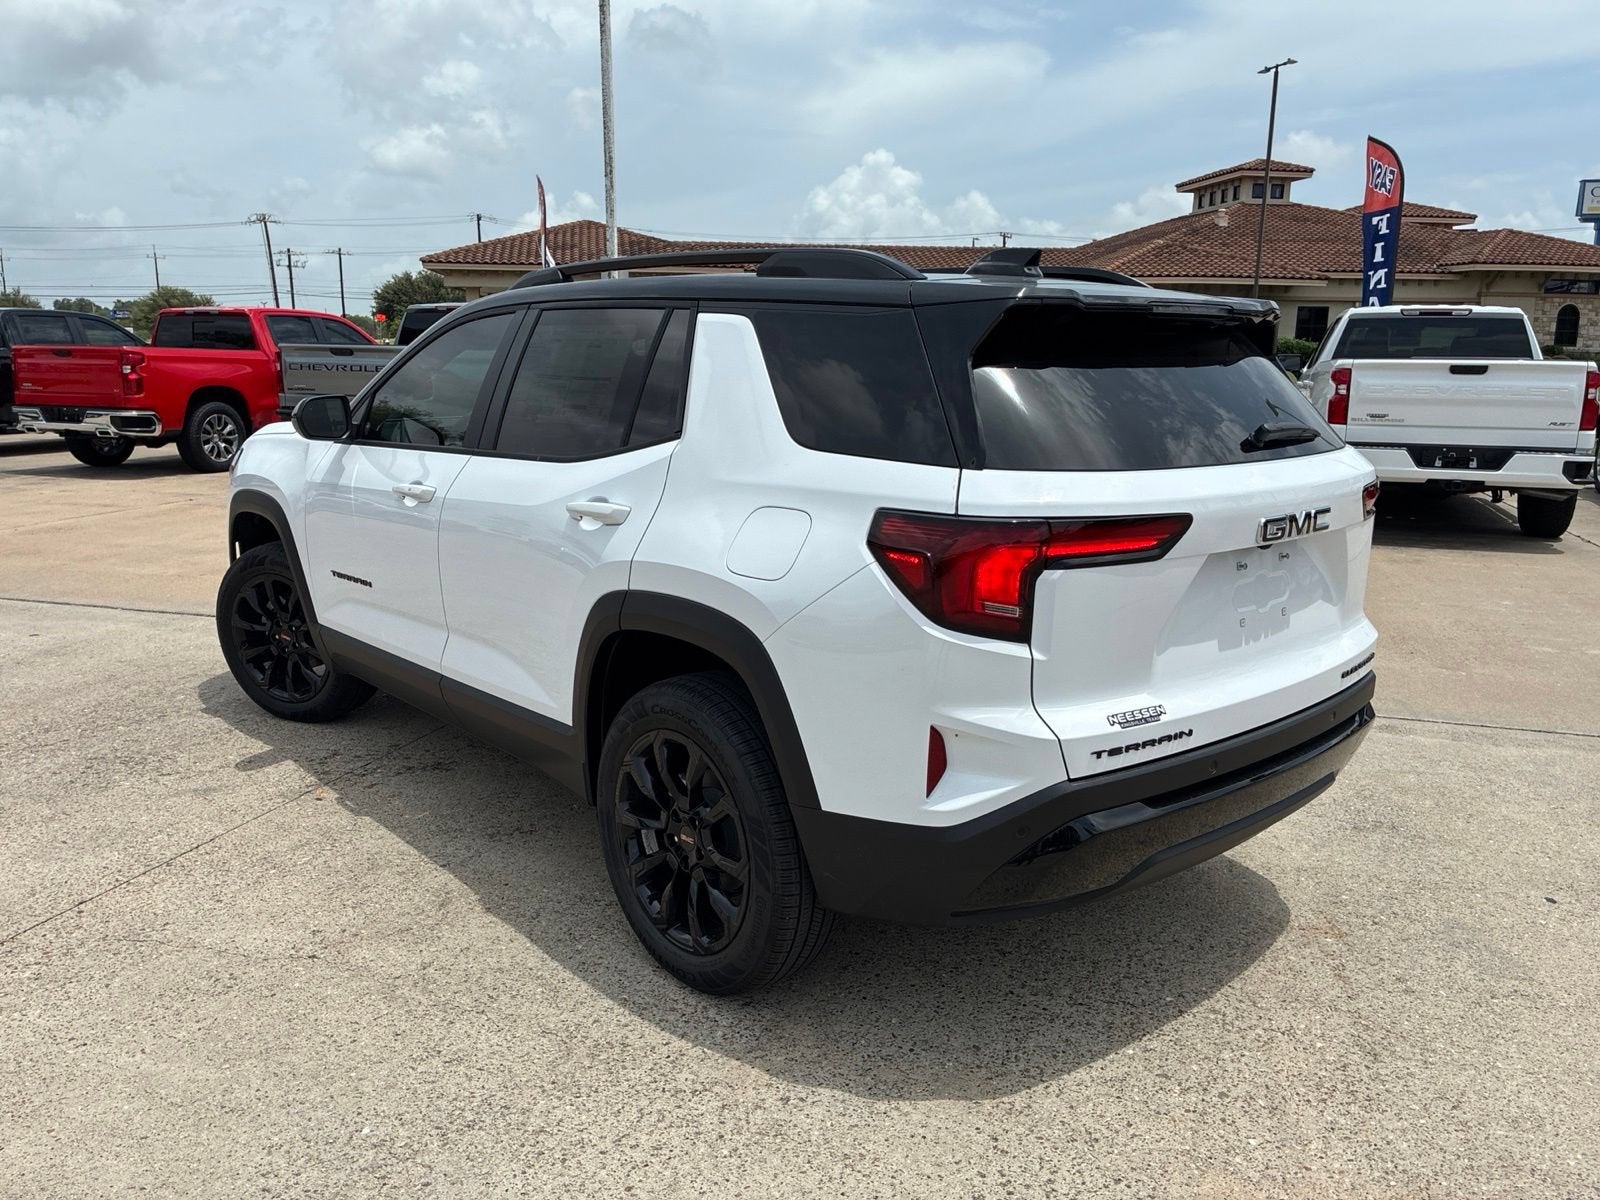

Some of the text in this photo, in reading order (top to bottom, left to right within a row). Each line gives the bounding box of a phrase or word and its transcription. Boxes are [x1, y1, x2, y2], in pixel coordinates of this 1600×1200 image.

[288, 363, 385, 372] CHEVROLE
[1257, 506, 1331, 542] GMC
[330, 569, 373, 588] TERRAIN
[1107, 705, 1166, 726] NEESSEN
[1090, 728, 1193, 759] TERRAIN
